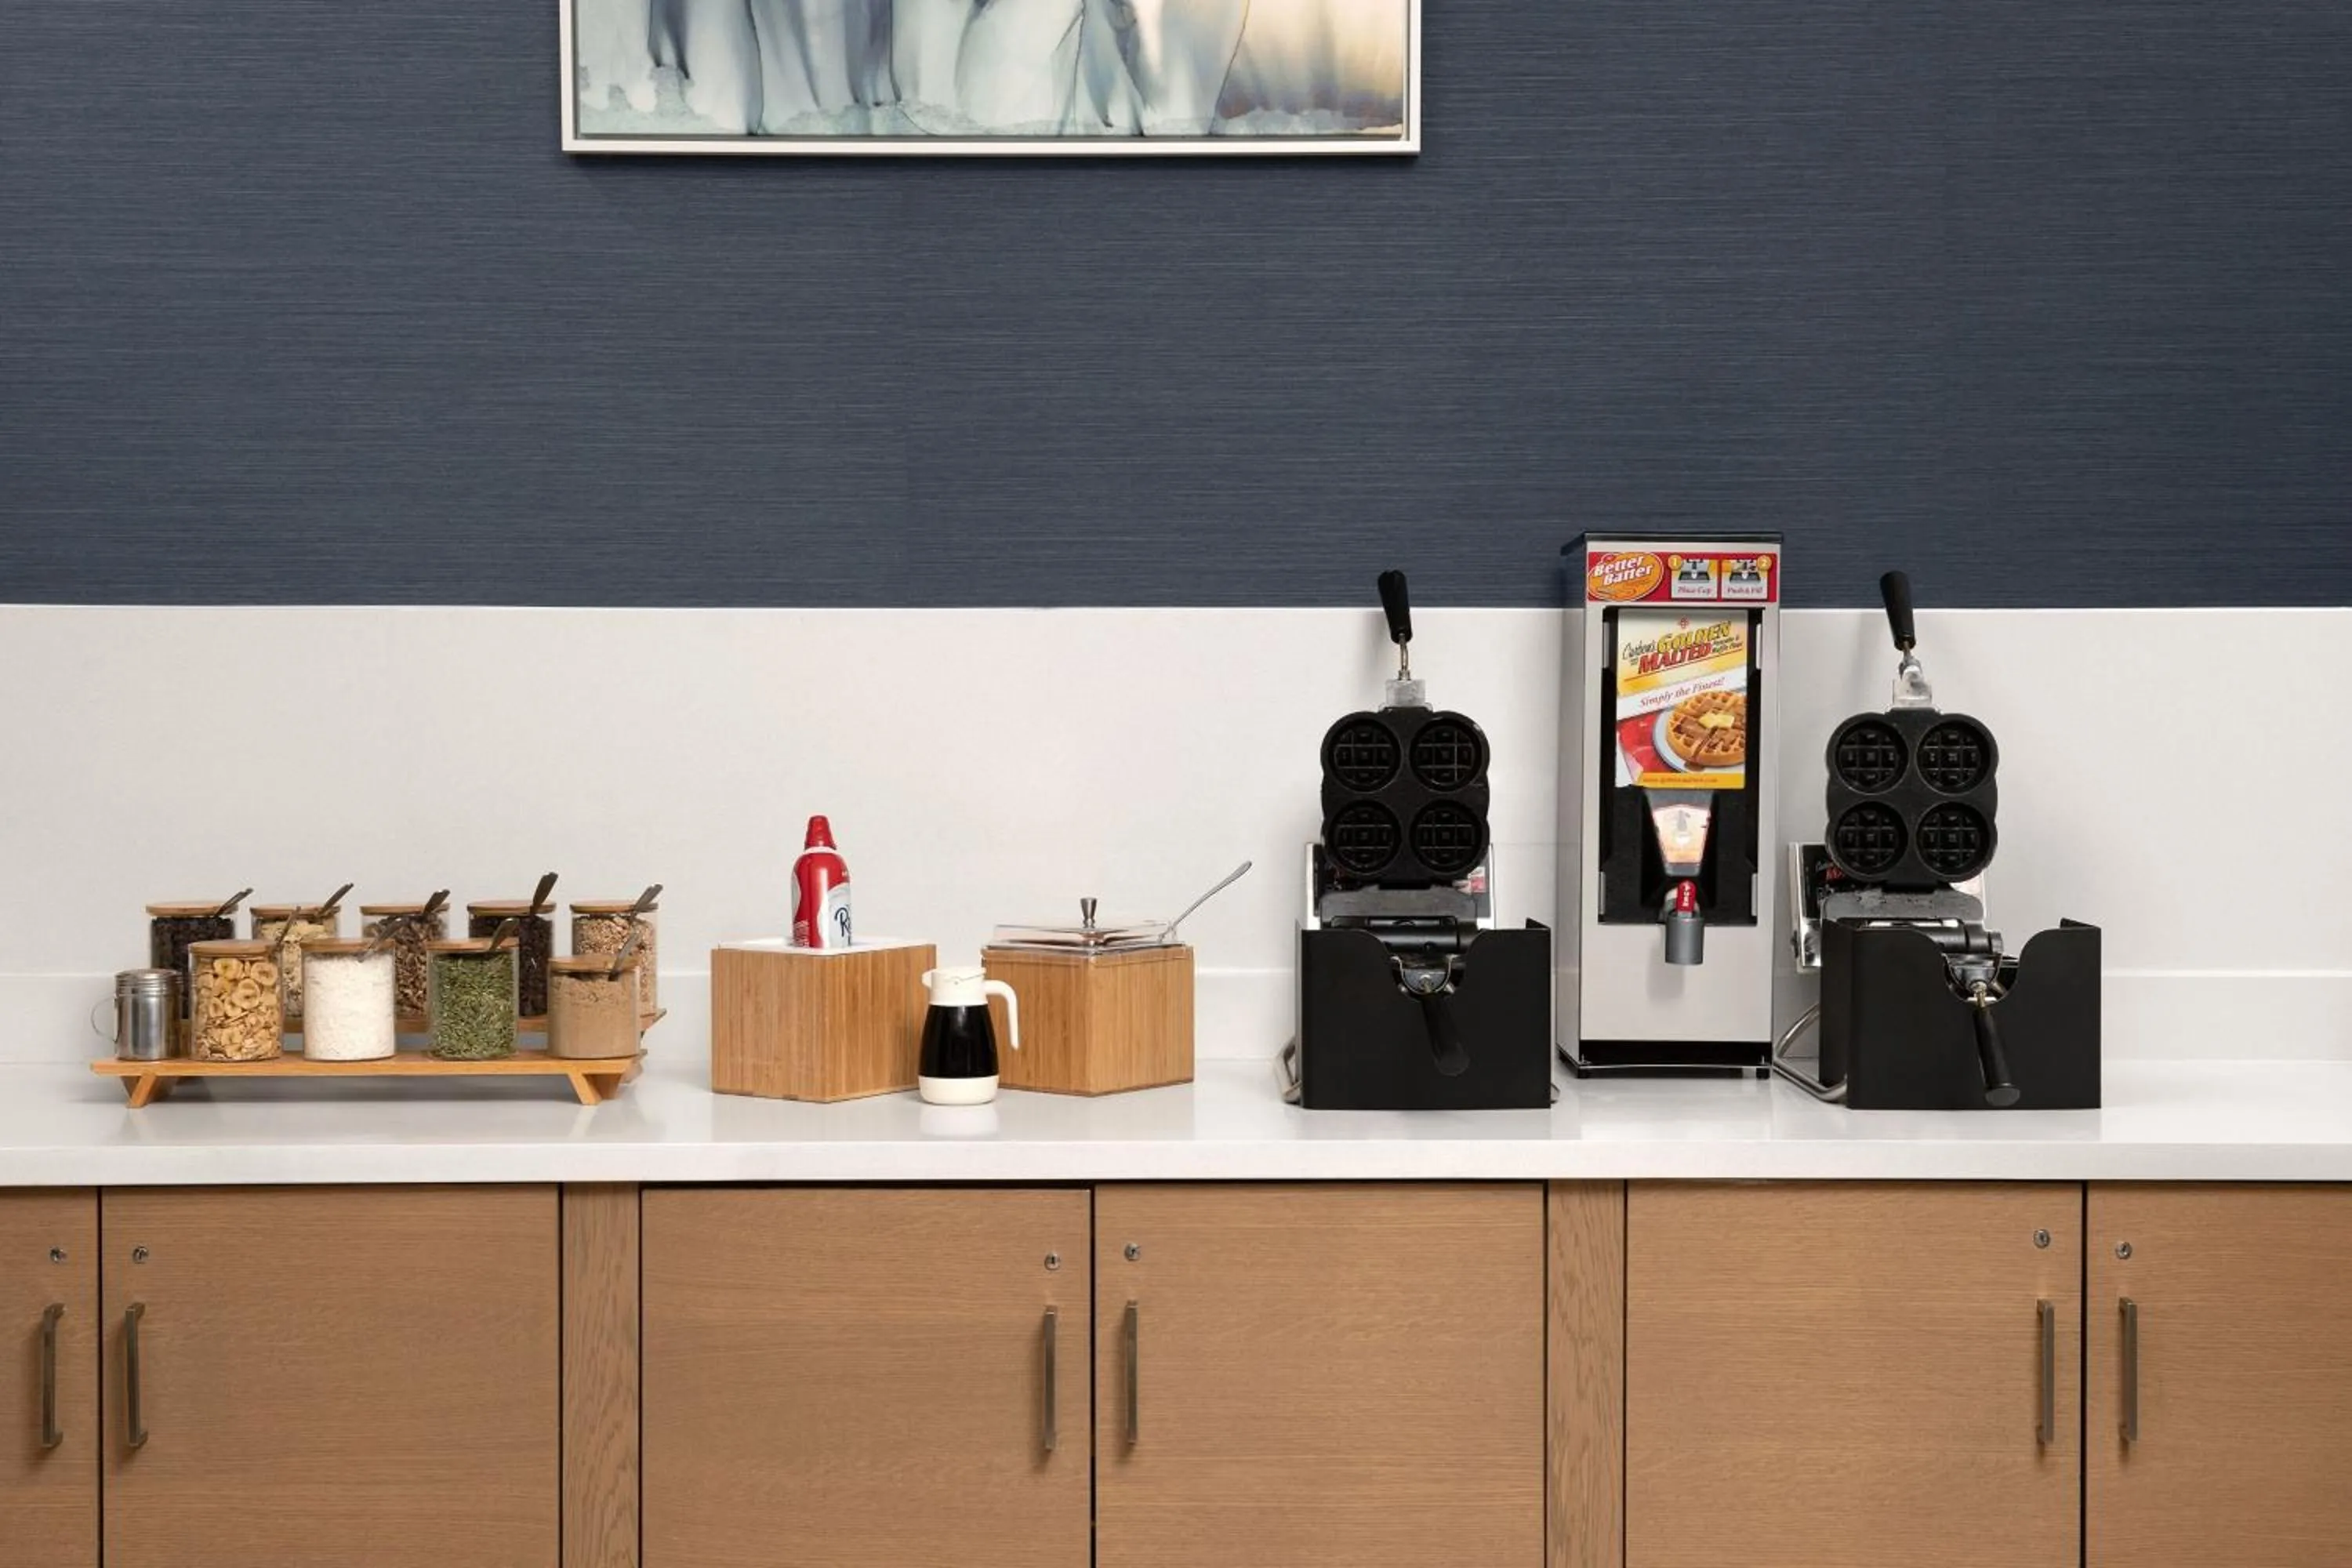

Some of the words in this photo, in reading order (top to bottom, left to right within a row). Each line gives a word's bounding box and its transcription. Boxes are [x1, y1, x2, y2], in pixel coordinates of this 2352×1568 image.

[1594, 556, 1644, 577] Better
[1672, 557, 1678, 567] 1
[1760, 558, 1767, 568] 2
[1603, 564, 1653, 586] Batter
[1657, 620, 1732, 654] GOLDEN
[1638, 641, 1712, 674] MALTED
[1640, 691, 1674, 706] Simply
[1675, 687, 1691, 698] the
